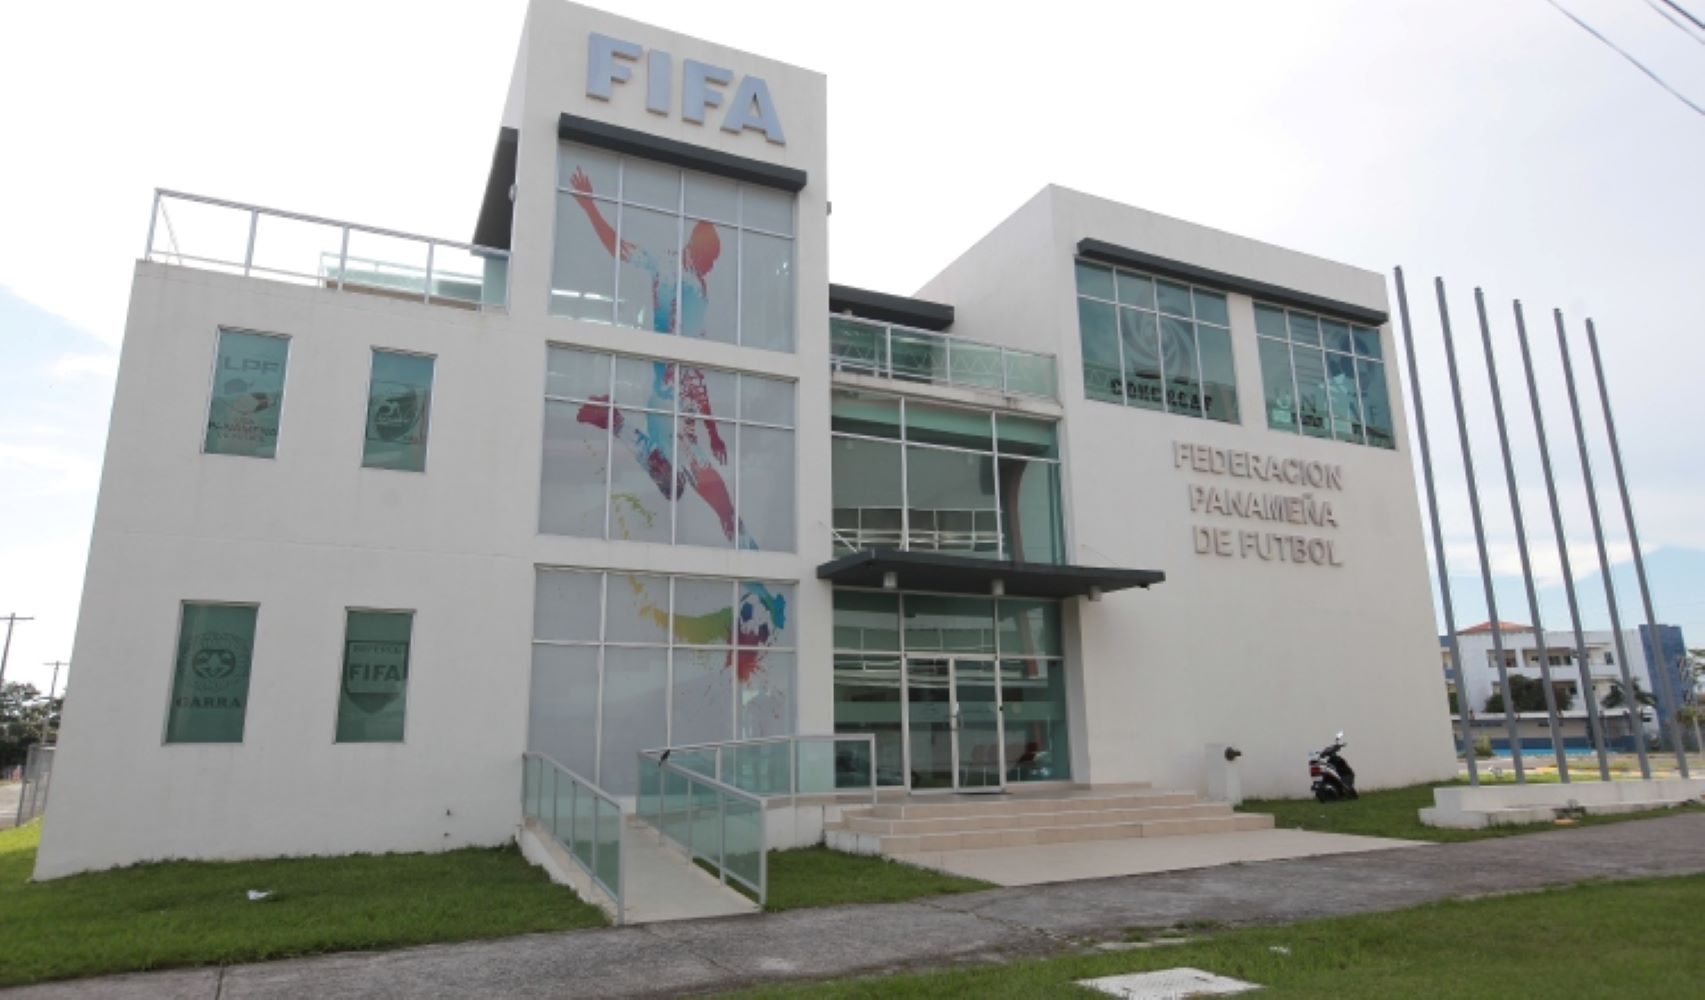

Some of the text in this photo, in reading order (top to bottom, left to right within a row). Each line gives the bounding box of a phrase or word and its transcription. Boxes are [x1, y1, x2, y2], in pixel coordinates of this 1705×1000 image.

[586, 32, 786, 146] FIFA
[1173, 440, 1343, 491] FEDERACION
[1189, 484, 1339, 528] PANAMEÑA
[1193, 525, 1343, 567] DE FUTBOL
[349, 663, 401, 681] FIFA
